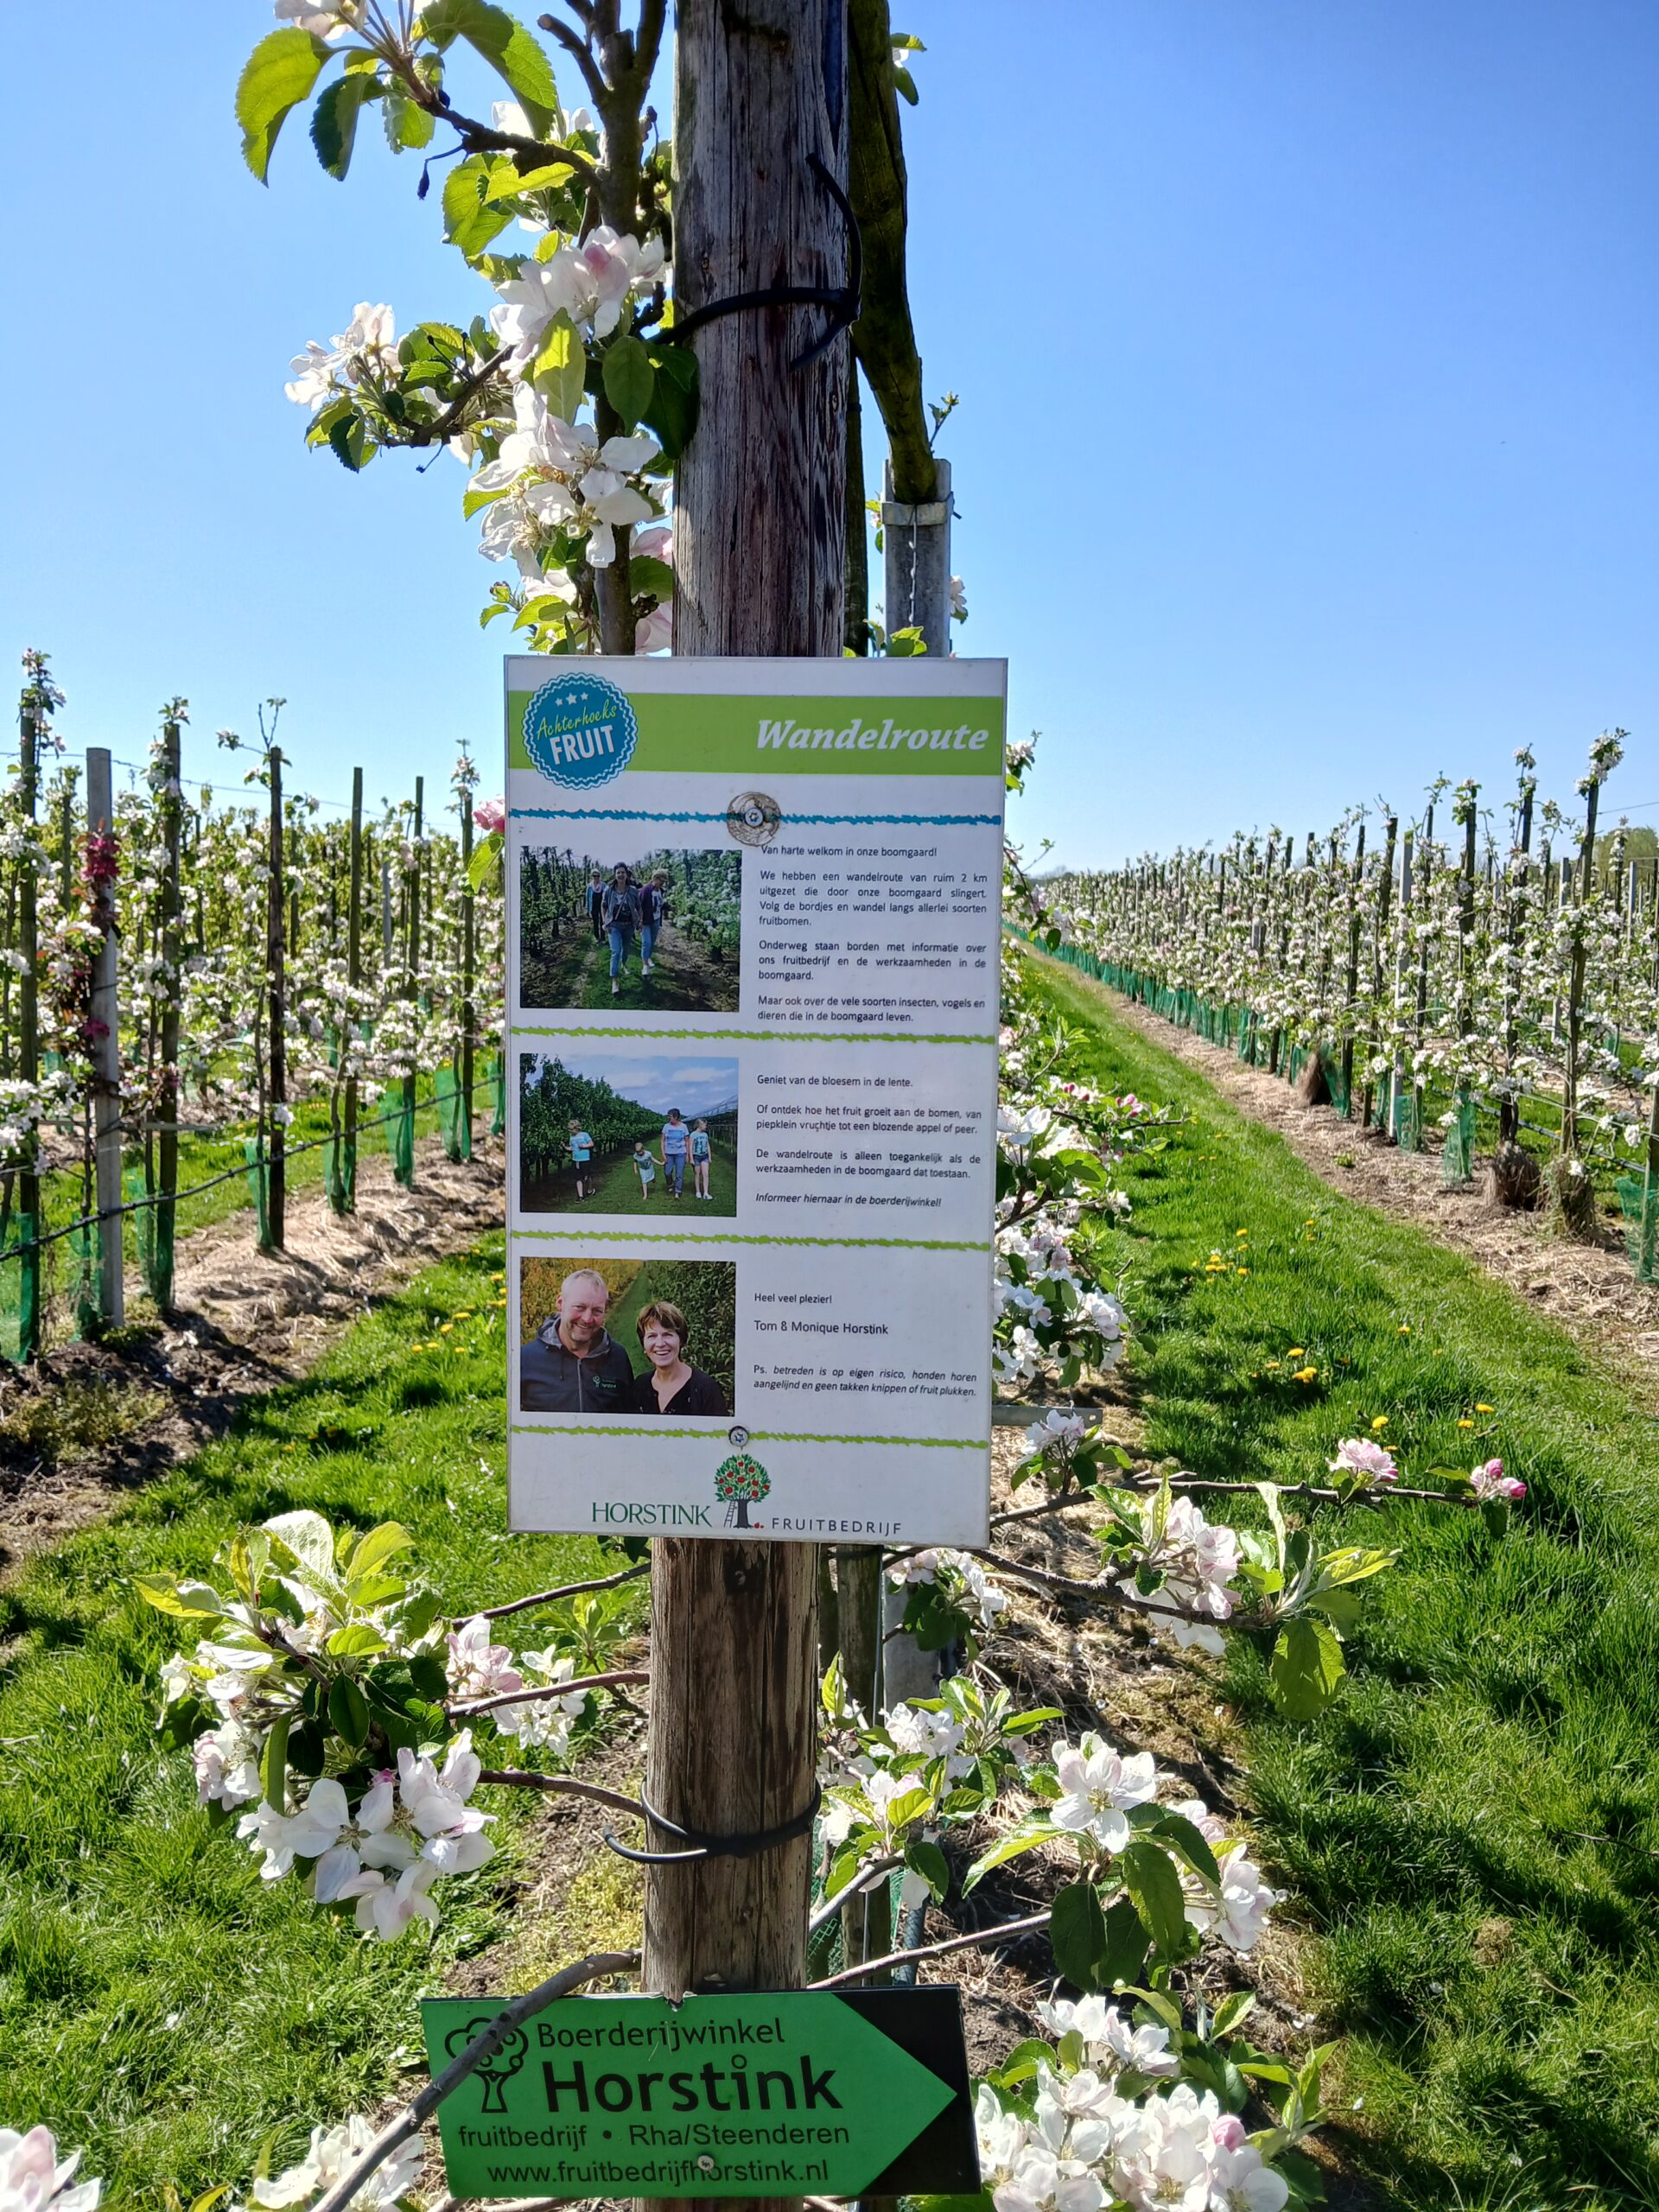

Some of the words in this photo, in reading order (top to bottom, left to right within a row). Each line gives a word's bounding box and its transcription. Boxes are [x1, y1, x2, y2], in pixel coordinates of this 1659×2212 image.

[537, 699, 617, 741] Achterhoeks
[756, 718, 989, 752] Wandelroute
[549, 724, 614, 766] FRUIT
[760, 845, 779, 855] Van
[780, 844, 805, 855] harte
[806, 846, 843, 856] welkom
[845, 846, 854, 856] in
[855, 848, 879, 856] onze
[880, 846, 937, 859] boomgaard!
[760, 869, 776, 880] We
[781, 870, 816, 881] hebben
[822, 873, 840, 881] een
[846, 871, 903, 882] wandelroute
[932, 872, 955, 882] ruim
[960, 873, 967, 882] 2
[973, 872, 988, 882] km
[759, 885, 796, 897] uitgezet
[804, 886, 818, 896] die
[827, 885, 849, 896] door
[857, 888, 880, 897] onze
[888, 887, 942, 899] boomgaard
[950, 887, 988, 900] slingert.
[759, 899, 780, 912] Volg
[783, 900, 795, 911] de
[798, 900, 833, 912] bordjes
[836, 903, 849, 912] en
[852, 901, 886, 912] wandel
[889, 901, 914, 914] langs
[917, 902, 949, 912] allerlei
[951, 904, 987, 913] soorten
[758, 914, 811, 925] fruitbomen.
[759, 939, 808, 952] Onderweg
[814, 942, 840, 950] staan
[846, 941, 880, 951] borden
[886, 943, 905, 952] met
[912, 942, 959, 952] informatie
[965, 944, 987, 953] over
[782, 954, 830, 967] fruitbedrijf
[836, 957, 849, 966] en
[855, 956, 868, 966] de
[874, 957, 951, 967] werkzaamheden
[958, 957, 968, 968] in
[974, 958, 986, 968] de
[758, 969, 814, 982] boomgaard.
[758, 995, 783, 1005] Maar
[784, 995, 802, 1006] ook
[803, 997, 825, 1007] over
[826, 995, 838, 1006] de
[840, 995, 860, 1006] vele
[861, 997, 897, 1007] soorten
[898, 997, 939, 1007] insecten,
[941, 998, 972, 1009] vogels
[973, 1000, 985, 1008] en
[757, 1010, 786, 1020] dieren
[788, 1010, 803, 1020] die
[804, 1011, 814, 1020] in
[816, 1011, 829, 1020] de
[830, 1011, 884, 1023] boomgaard
[885, 1012, 913, 1021] leven.
[756, 1074, 787, 1084] Geniet
[788, 1077, 805, 1085] van
[807, 1075, 820, 1085] de
[822, 1075, 861, 1085] bloesem
[862, 1077, 872, 1086] in
[874, 1077, 886, 1087] de
[887, 1077, 912, 1087] lente.
[756, 1103, 768, 1114] Of
[770, 1104, 802, 1115] ontdek
[804, 1105, 822, 1115] hoe
[824, 1105, 841, 1116] het
[842, 1106, 861, 1116] fruit
[863, 1106, 892, 1118] groeit
[912, 1107, 925, 1117] de
[927, 1108, 962, 1119] bomen,
[755, 1119, 797, 1132] piepklein
[798, 1120, 836, 1133] vruchtje
[838, 1122, 852, 1131] tot
[872, 1121, 913, 1131] blozende
[915, 1122, 941, 1134] appel
[943, 1123, 953, 1133] of
[954, 1125, 977, 1135] peer.
[756, 1148, 769, 1159] De
[774, 1149, 833, 1160] wandelroute
[839, 1150, 848, 1160] is
[854, 1150, 882, 1160] alleen
[888, 1152, 943, 1164] toegankelijk
[949, 1154, 963, 1163] als
[969, 1154, 981, 1164] de
[755, 1163, 831, 1173] werkzaamheden
[833, 1165, 842, 1174] in
[843, 1165, 856, 1175] de
[858, 1165, 911, 1178] boomgaard
[912, 1166, 928, 1178] dat
[929, 1168, 970, 1179] toestaan.
[755, 1192, 802, 1203] Informeer
[803, 1193, 843, 1204] hiernaar
[843, 1194, 853, 1204] in
[855, 1195, 868, 1205] de
[868, 1195, 942, 1207] boerderijwinkel!
[753, 1293, 775, 1302] Heel
[777, 1294, 797, 1303] veel
[798, 1294, 832, 1305] plezier!
[753, 1320, 778, 1332] Tom
[780, 1320, 788, 1332] &
[791, 1320, 839, 1335] Monique
[842, 1322, 888, 1335] Horstink
[753, 1363, 767, 1374] Ps.
[772, 1364, 814, 1376] betreden
[818, 1366, 827, 1376] is
[831, 1369, 844, 1378] op
[849, 1368, 874, 1379] eigen
[879, 1368, 906, 1379] risico,
[912, 1369, 946, 1380] honden
[950, 1371, 977, 1382] horen
[753, 1379, 801, 1390] aangelijnd
[813, 1382, 837, 1392] geen
[839, 1382, 869, 1392] takken
[870, 1382, 907, 1395] knippen
[908, 1384, 919, 1394] of
[919, 1384, 938, 1395] fruit
[938, 1385, 976, 1396] plukken.
[592, 1502, 713, 1528] HORSTINK
[772, 1517, 902, 1536] FRUITBEDRIJF
[537, 2018, 786, 2051] Boerderijwinkel
[541, 2054, 844, 2113] Horstink
[458, 2125, 588, 2152] fruitbedrijf
[628, 2123, 850, 2147] Rha/Steenderen
[487, 2159, 830, 2188] www.fruitbedrijfhorstink.nl
